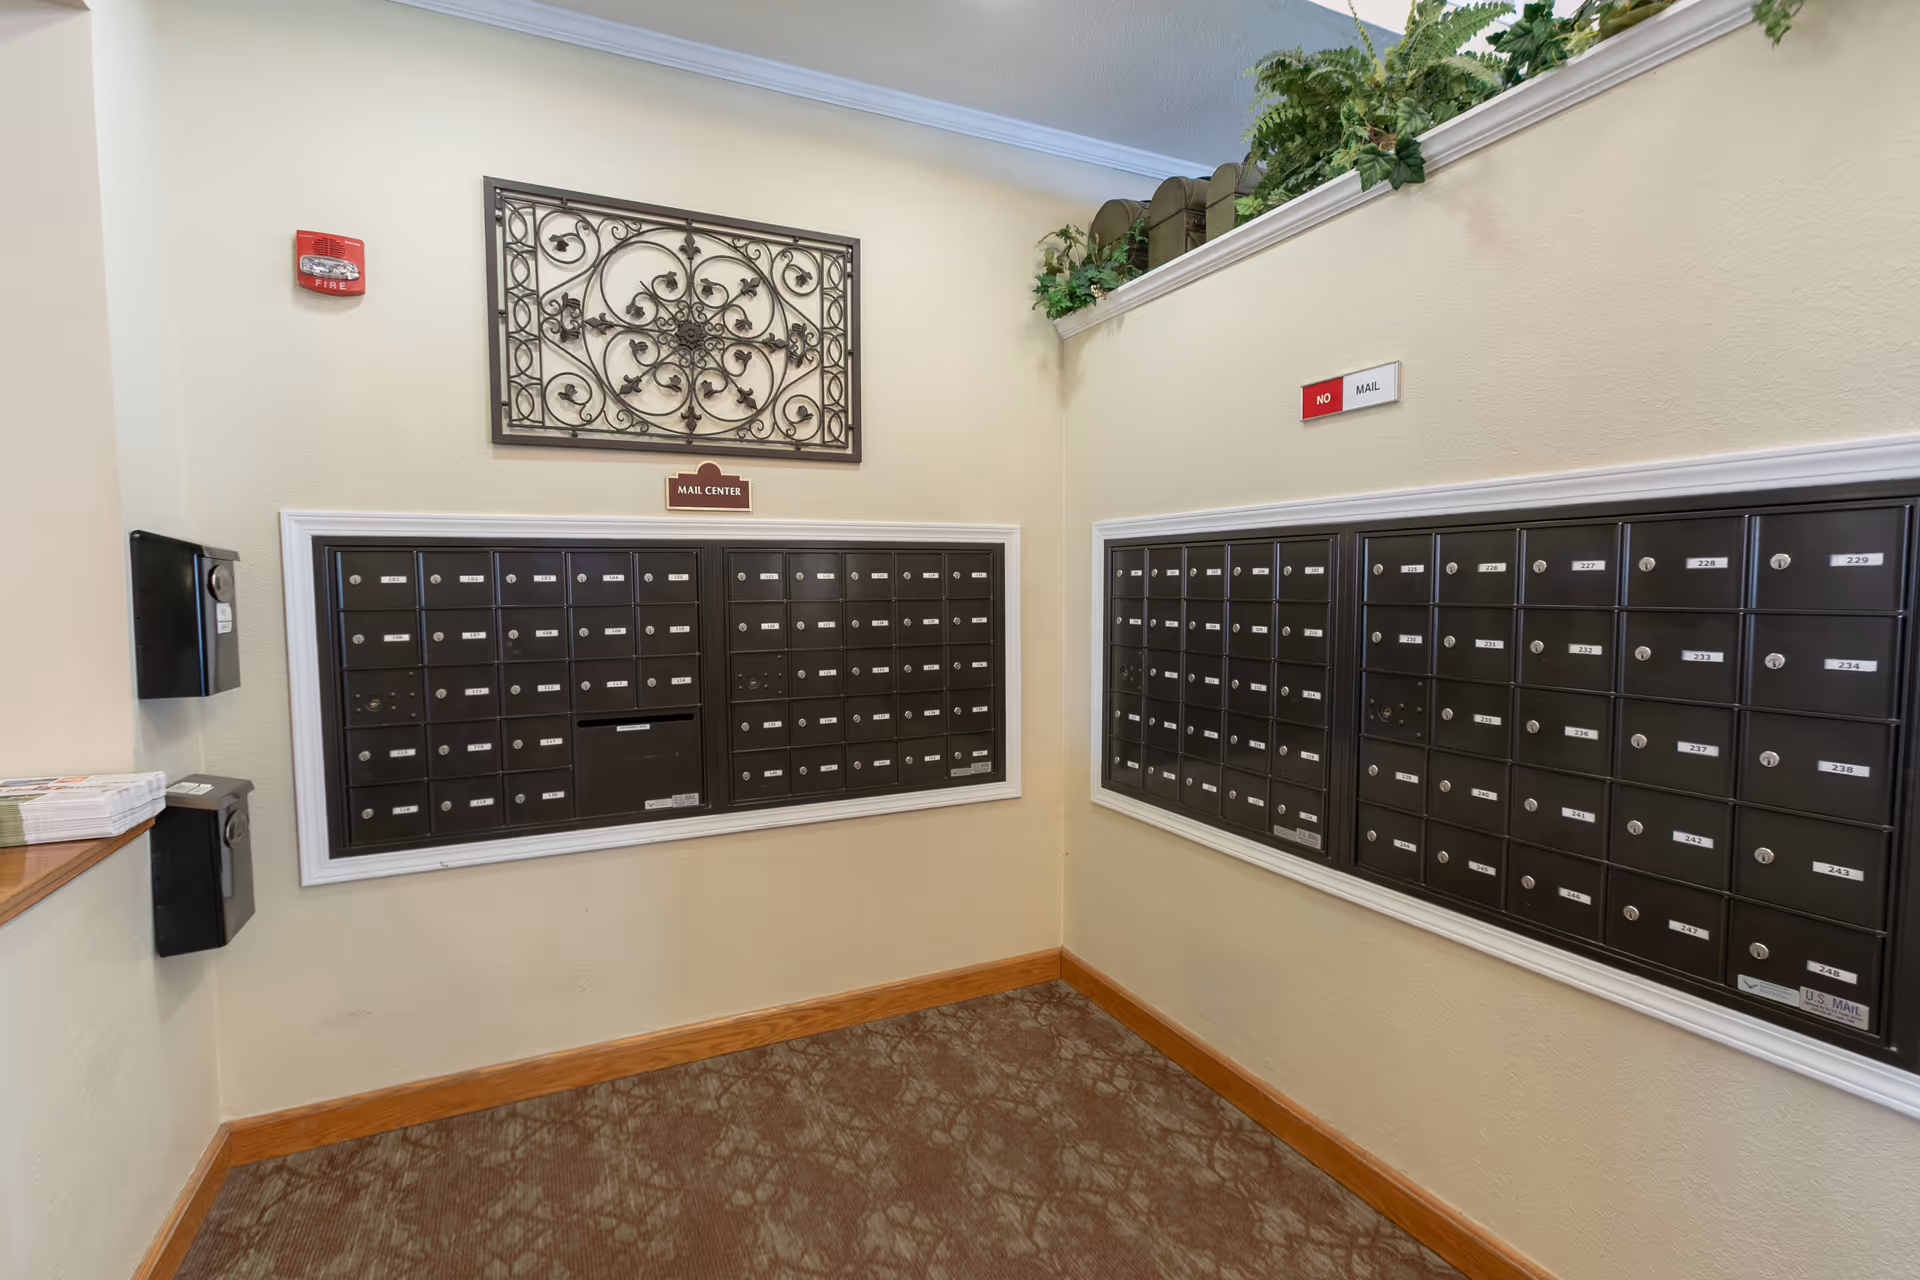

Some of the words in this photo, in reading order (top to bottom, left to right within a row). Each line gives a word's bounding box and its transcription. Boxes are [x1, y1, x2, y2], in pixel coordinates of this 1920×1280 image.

[315, 279, 347, 290] FIRE
[1316, 392, 1331, 405] NO
[1356, 381, 1380, 395] MAIL
[678, 485, 702, 495] MAIL
[705, 486, 741, 495] CENTER
[1698, 559, 1716, 568] 228
[1847, 555, 1869, 566] 229
[1579, 645, 1592, 654] 232
[1694, 653, 1711, 661] 233
[1574, 729, 1589, 737] 236
[1690, 745, 1707, 753] 237
[1832, 764, 1854, 773] 238
[1572, 811, 1585, 819] 241
[1685, 835, 1702, 844] 242
[1477, 864, 1488, 872] 245
[1828, 866, 1850, 876] 243
[1567, 891, 1581, 900] 246
[1681, 925, 1698, 934] 247
[1819, 965, 1840, 978] 248
[1806, 990, 1828, 1005] U.S.
[1832, 998, 1861, 1016] MAIL
